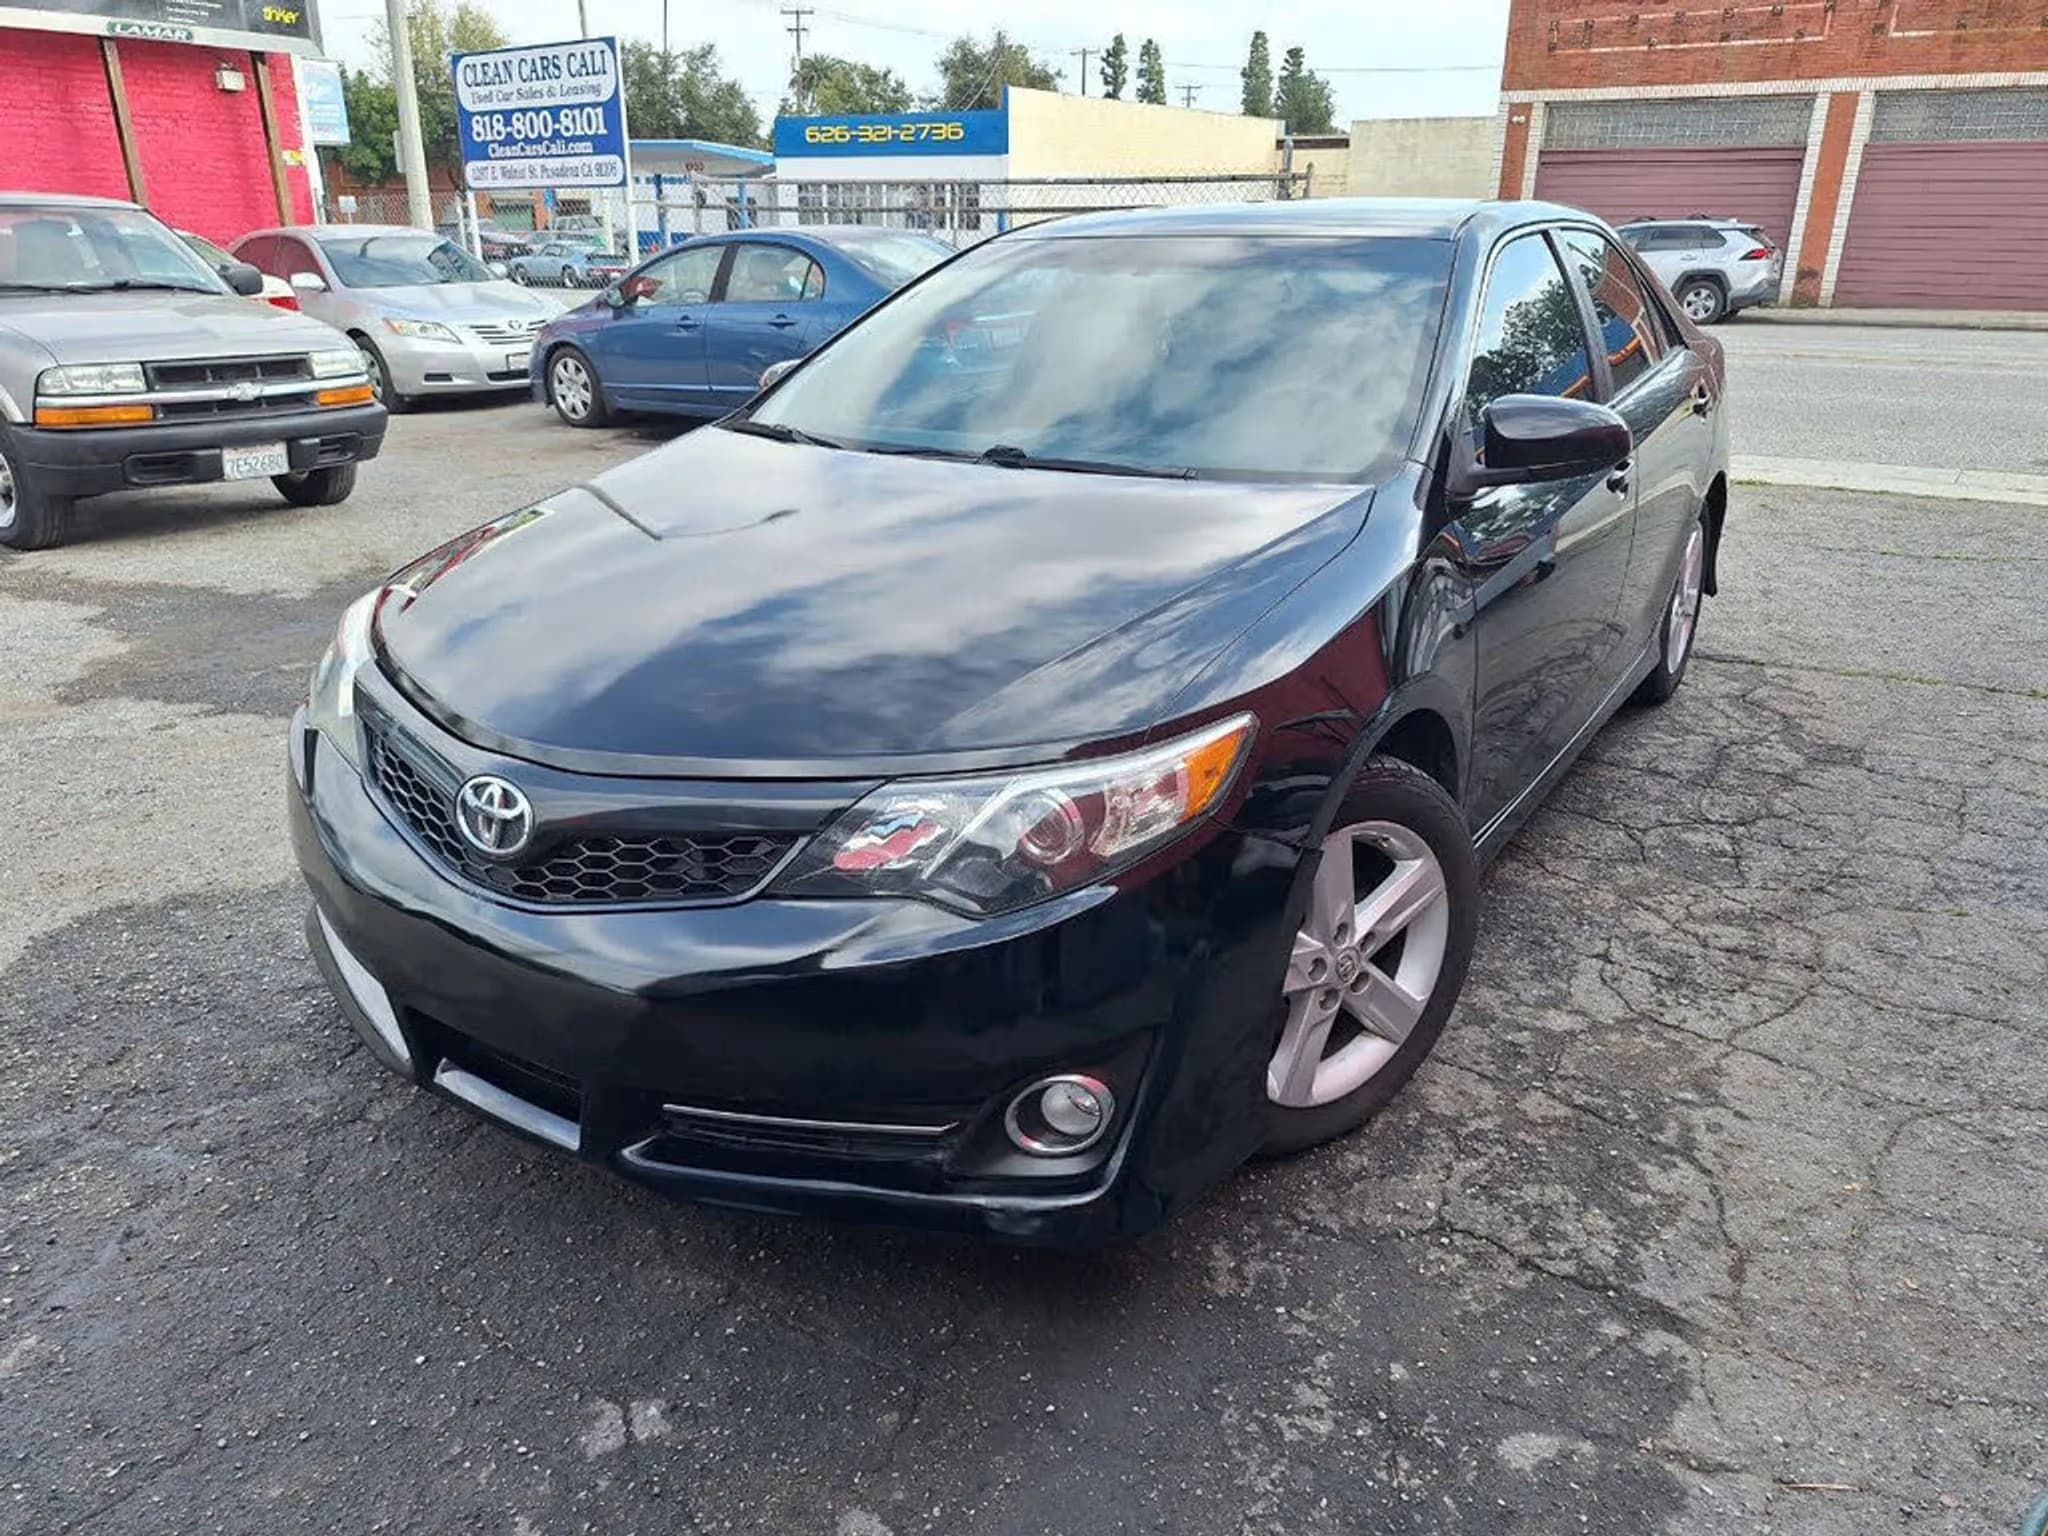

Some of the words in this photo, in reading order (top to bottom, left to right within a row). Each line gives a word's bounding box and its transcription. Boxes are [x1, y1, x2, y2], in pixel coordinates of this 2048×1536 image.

[115, 22, 188, 41] LAMAR
[463, 59, 513, 87] CLEAN
[518, 54, 562, 83] CARS
[566, 50, 607, 78] CALI
[471, 90, 493, 105] Used
[496, 90, 514, 102] Car
[516, 87, 544, 101] Sales
[545, 85, 556, 98] &
[559, 82, 601, 98] Leasing
[471, 106, 608, 142] 818-800-8101
[805, 122, 964, 144] 626-321-2736
[488, 140, 593, 159] CleanCarsCali.com
[540, 162, 579, 179] Pasadena
[580, 161, 593, 177] CA
